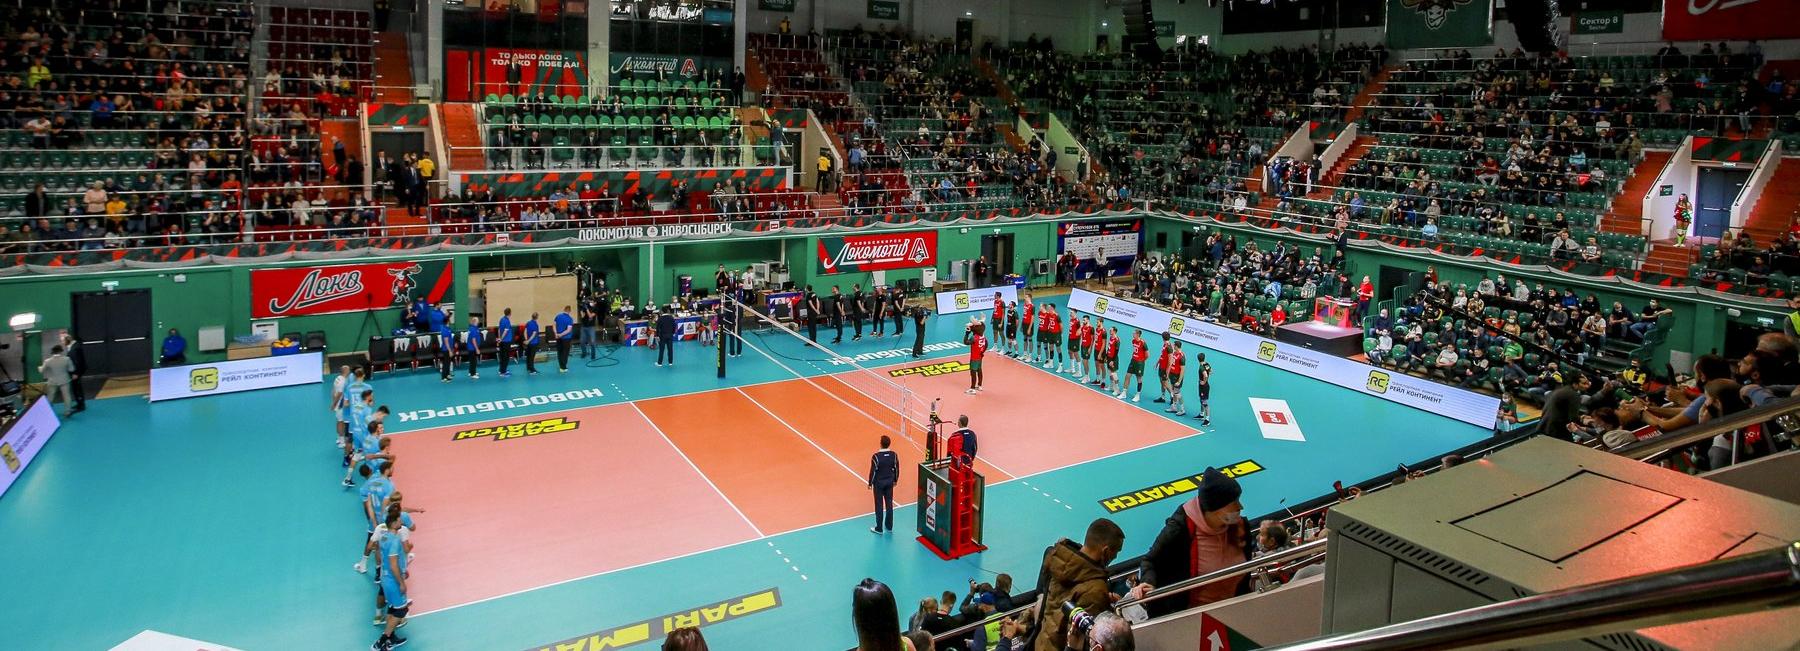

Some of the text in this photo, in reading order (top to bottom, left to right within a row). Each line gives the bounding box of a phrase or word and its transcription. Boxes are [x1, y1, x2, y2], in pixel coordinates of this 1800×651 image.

[1580, 16, 1618, 25] Сектор 8
[491, 58, 580, 69] ТОЛКО ПОБЕДА!
[538, 53, 562, 61] ЛОКО
[578, 222, 732, 241] ЛОКОМОТИВ НОВОСИБИРСК
[1289, 357, 1319, 370] КОНТИНЕНТ
[192, 373, 214, 385] RC
[244, 370, 287, 380] КОНТИНЕНТ
[1369, 376, 1386, 388] RC
[1389, 385, 1442, 404] РЕЙЛ КОНТИНЕНТ
[398, 387, 605, 422] НОВОСИБИРСК
[457, 418, 563, 440] MATCH
[496, 421, 577, 440] PARI
[1103, 479, 1198, 512] MATCH
[663, 591, 776, 635] PARI
